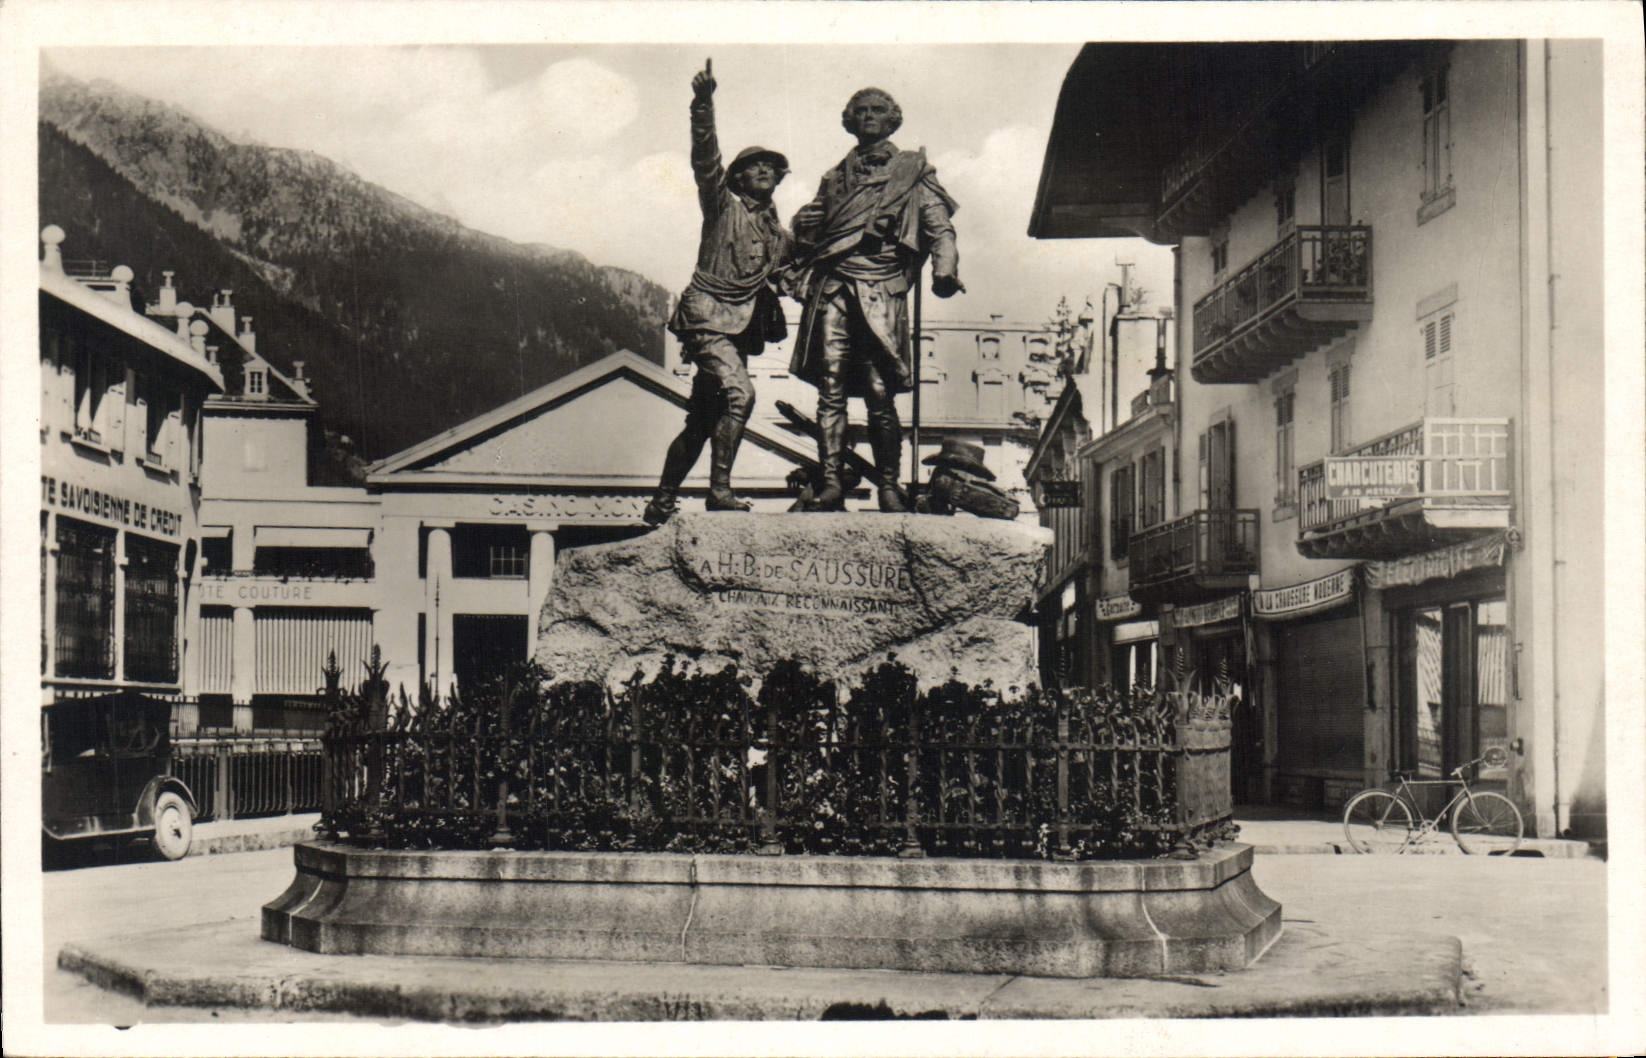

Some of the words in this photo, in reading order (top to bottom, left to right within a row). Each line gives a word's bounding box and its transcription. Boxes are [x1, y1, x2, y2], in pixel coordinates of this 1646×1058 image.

[61, 481, 130, 525] SAVOISIENNE
[134, 502, 147, 529] DE
[150, 507, 183, 537] CREDIT
[489, 495, 577, 517] CASINO
[764, 564, 785, 580] DE
[789, 559, 910, 592] SAUSSURE
[238, 586, 312, 600] COUTURE
[786, 595, 895, 616] RECONNAISSANT
